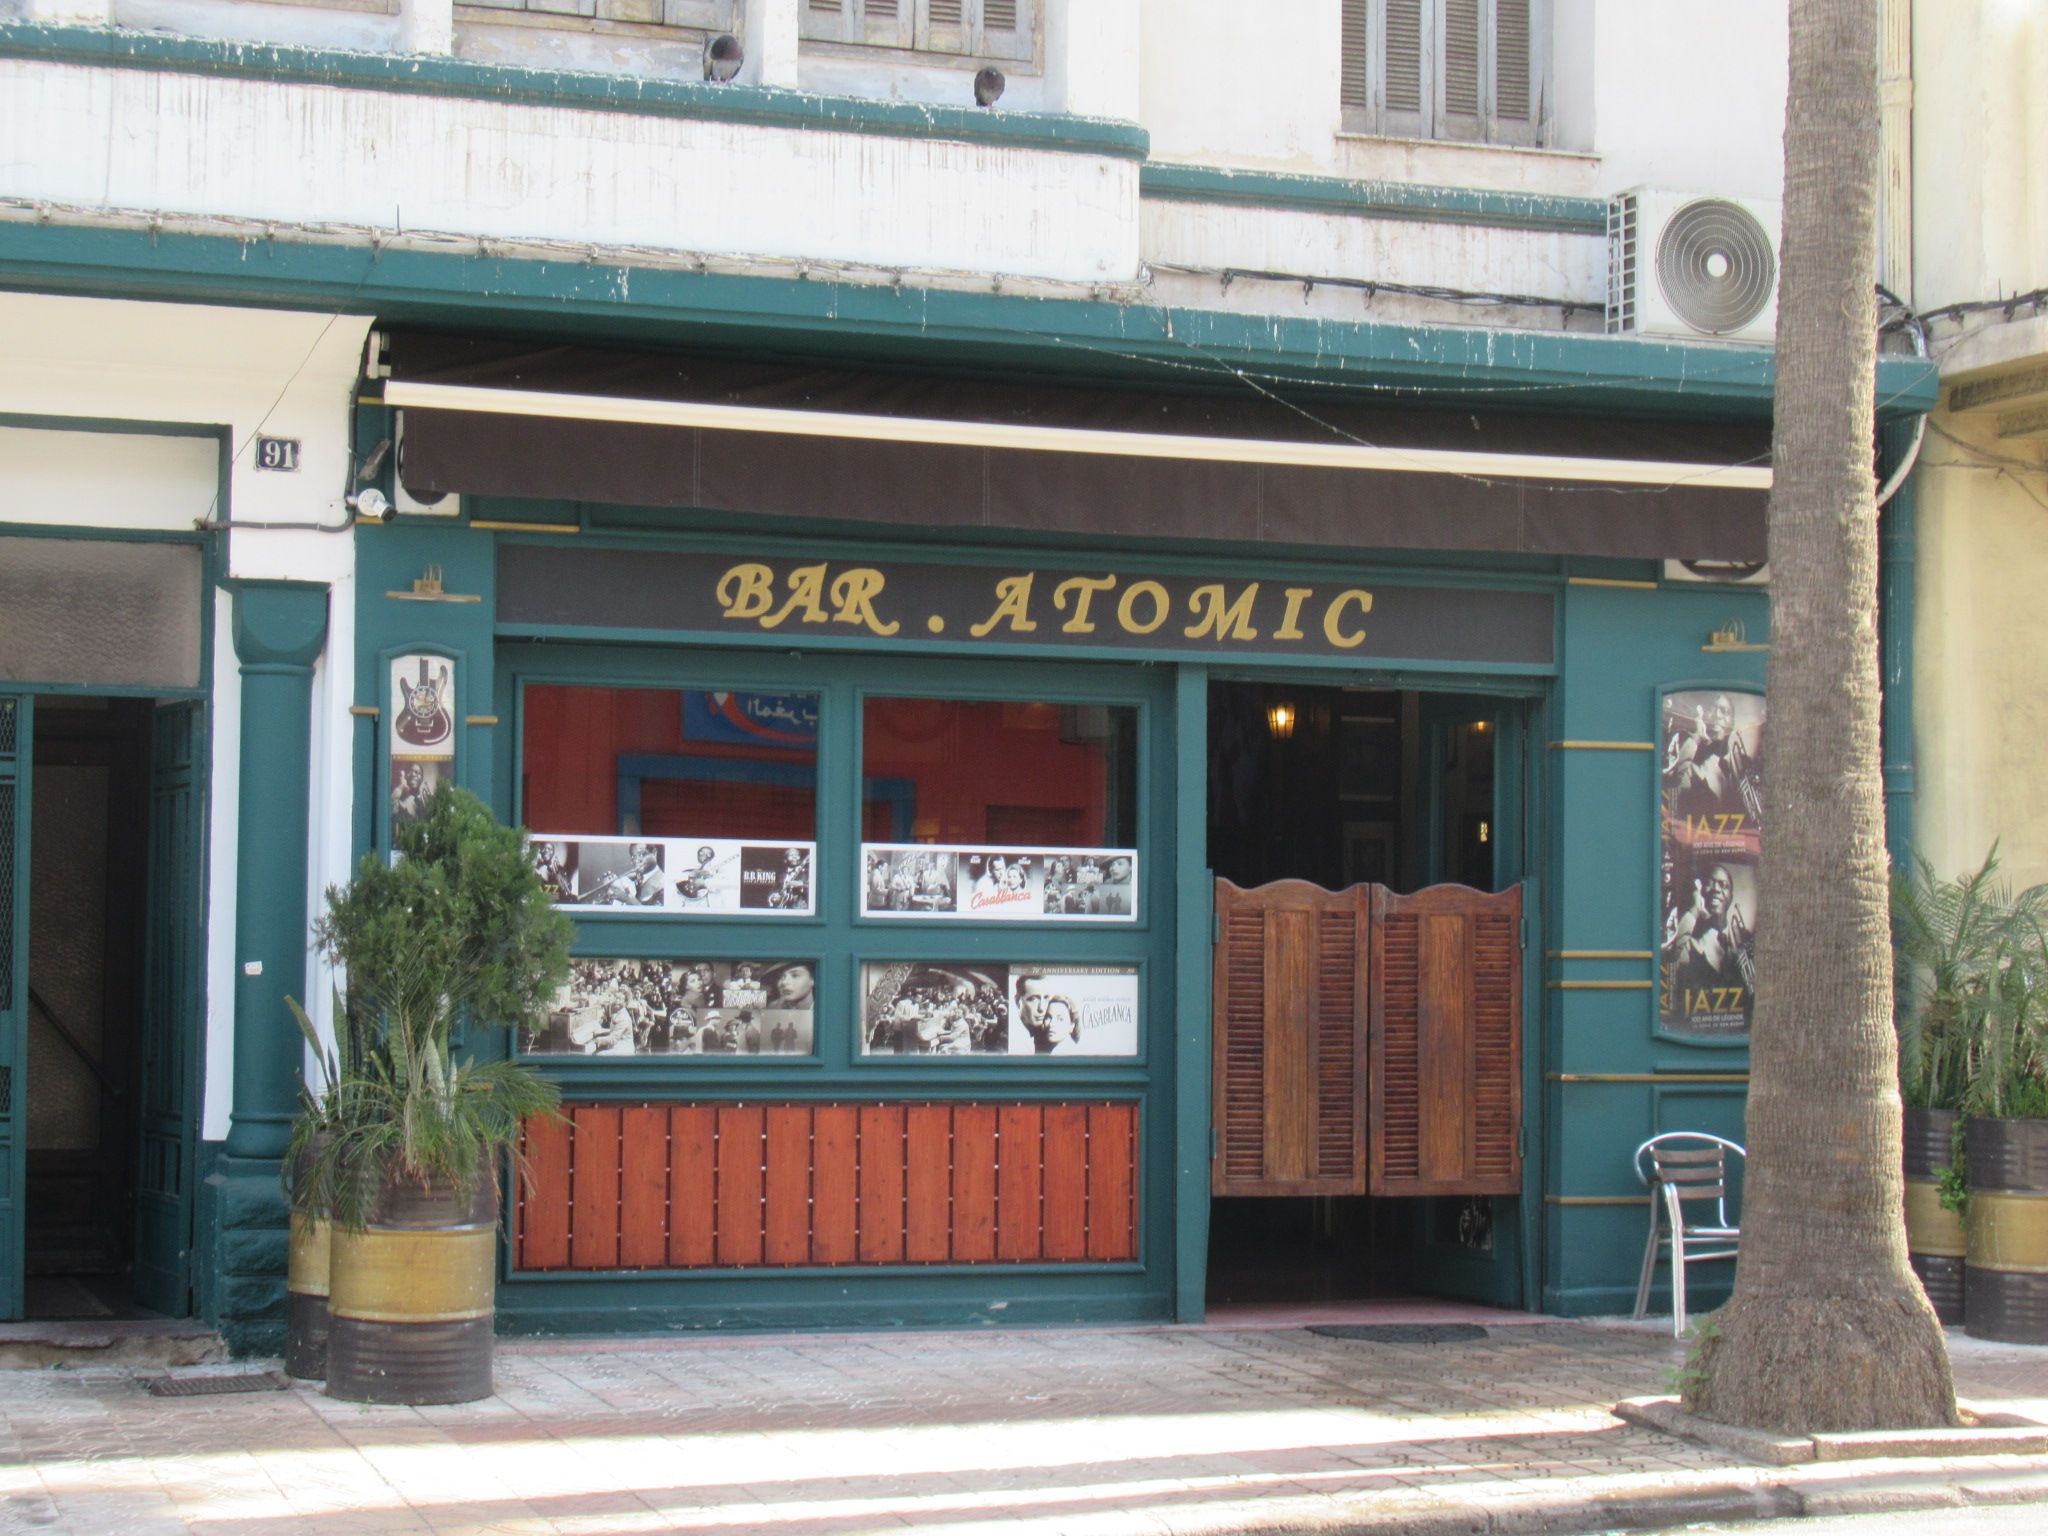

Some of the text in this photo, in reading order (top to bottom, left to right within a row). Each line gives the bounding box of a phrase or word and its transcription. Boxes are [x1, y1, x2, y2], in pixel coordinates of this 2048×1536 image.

[264, 440, 294, 468] 91
[716, 562, 900, 636] BAR
[969, 571, 1373, 648] ATOMIC
[1686, 814, 1745, 845] JAZZ
[971, 887, 1032, 910] Casablanca
[1042, 966, 1088, 974] ANNIVERSARY
[1091, 966, 1120, 974] EDITION
[1081, 1002, 1132, 1029] CASABLANCA
[1684, 987, 1744, 1018] JAZZ
